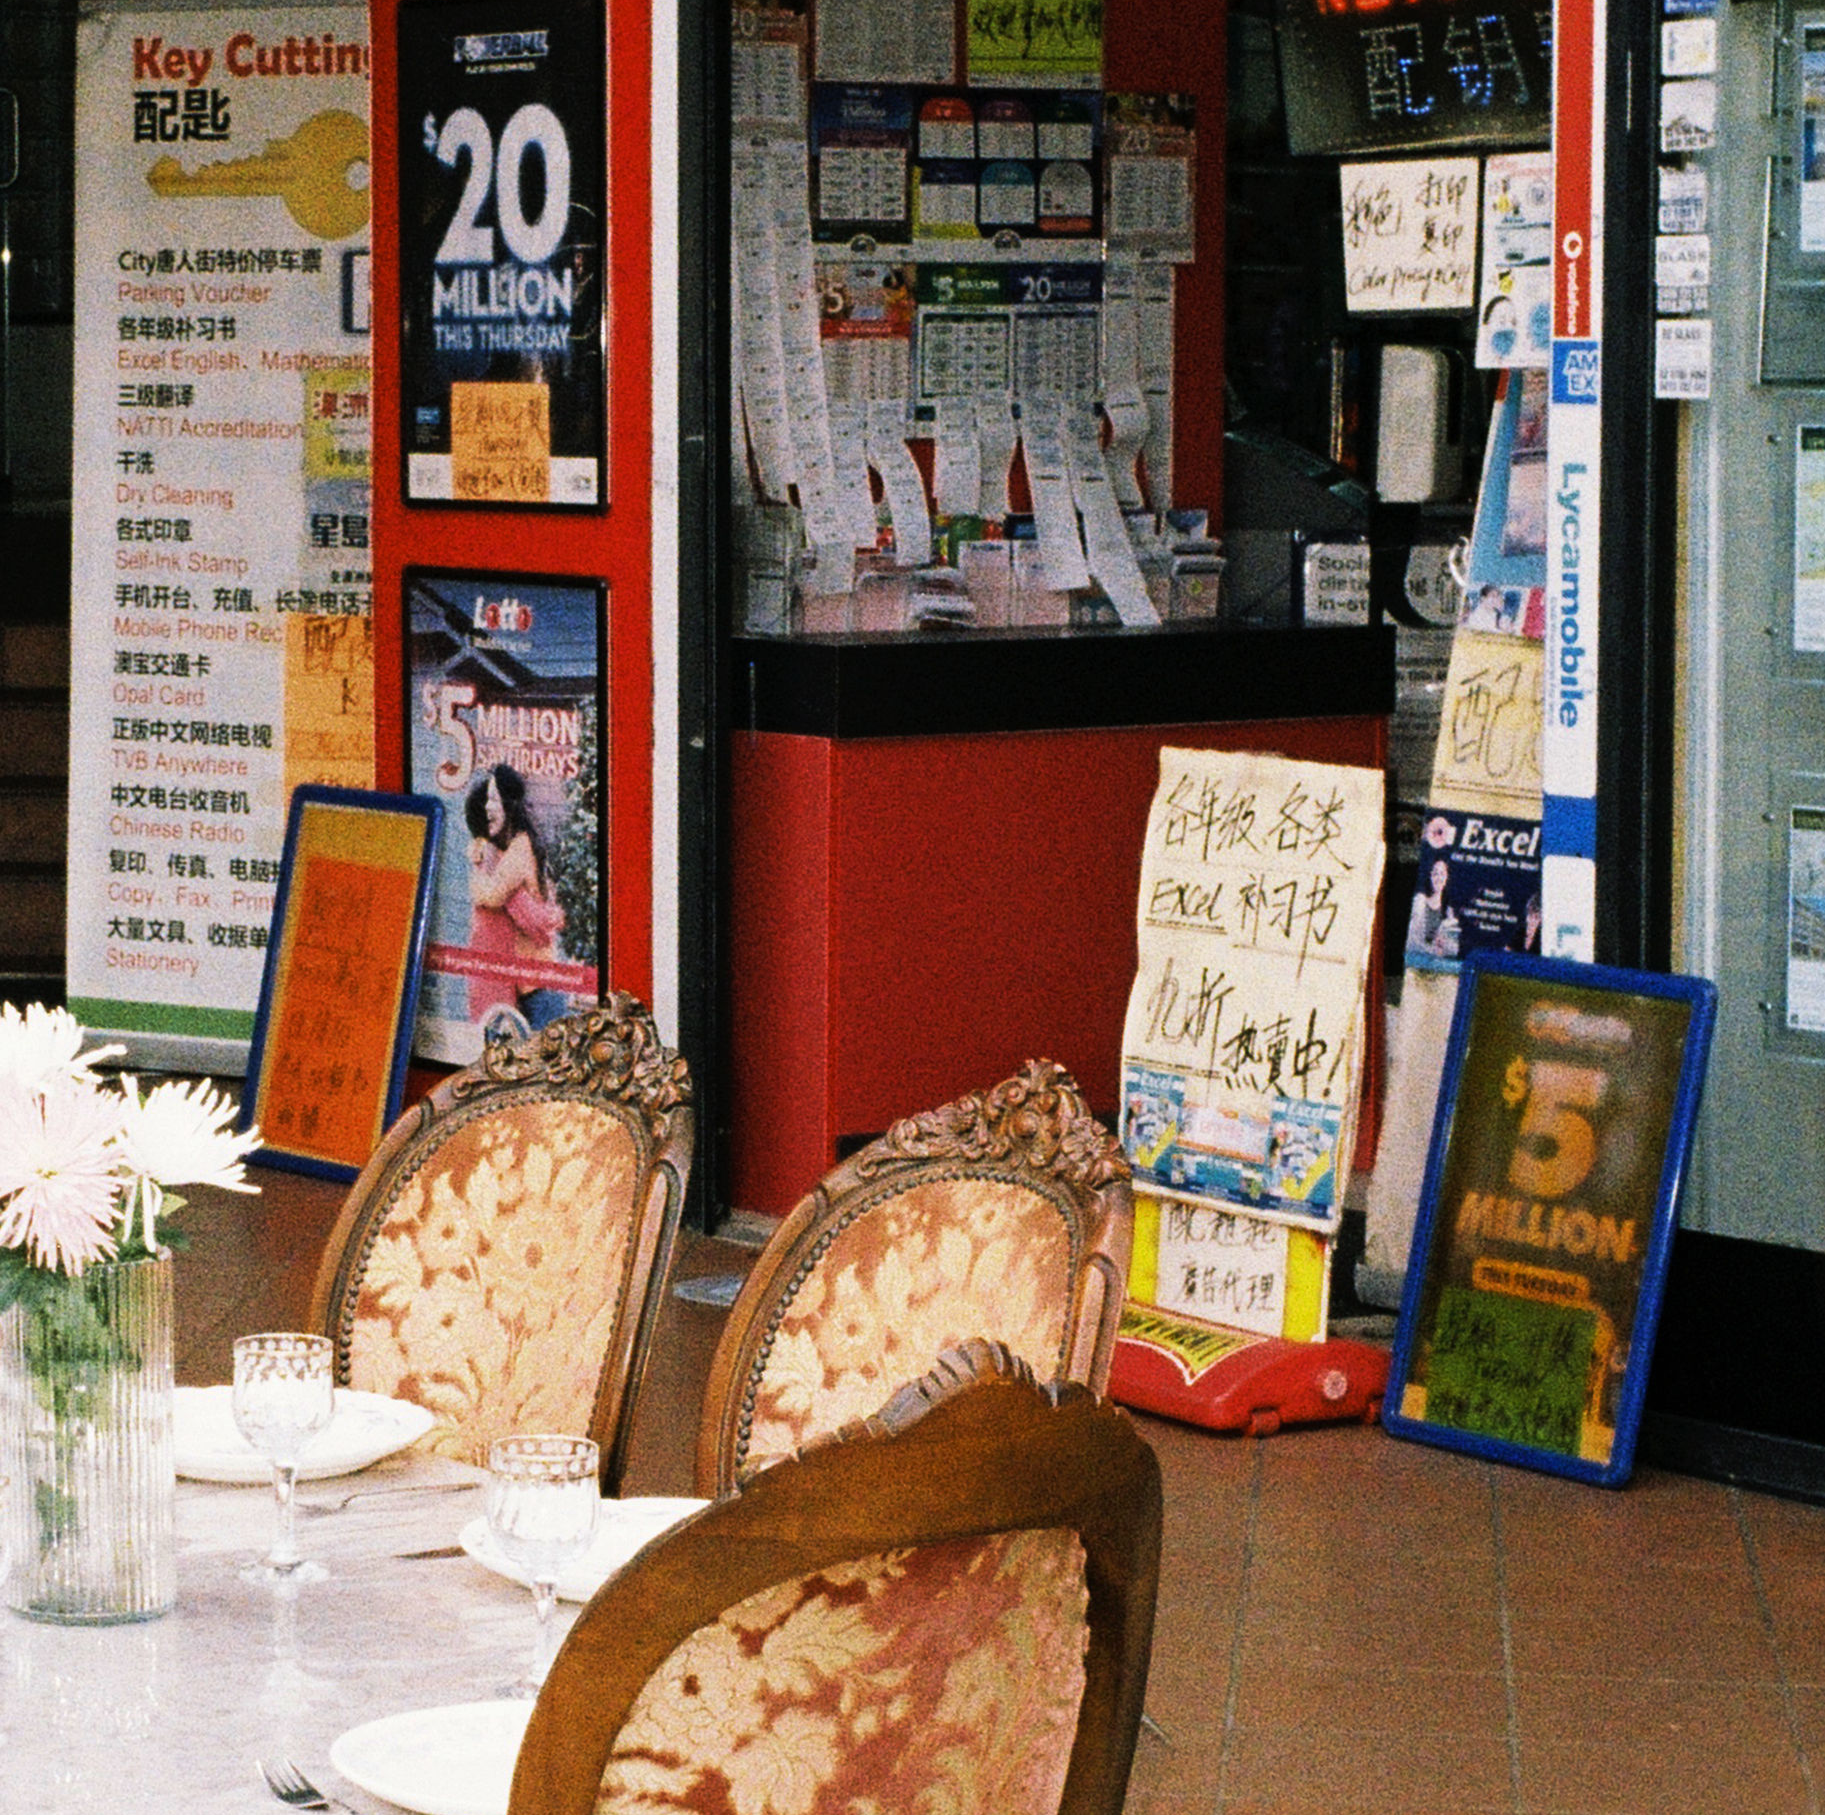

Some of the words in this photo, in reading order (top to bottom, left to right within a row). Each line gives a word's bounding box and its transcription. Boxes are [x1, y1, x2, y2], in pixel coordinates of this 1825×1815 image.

[132, 35, 215, 87] Key
[132, 88, 232, 144] 配匙
[422, 101, 572, 267] $20
[192, 281, 273, 306] Voucher
[432, 266, 574, 319] MILLION
[434, 322, 476, 350] THIS
[480, 322, 571, 351] THURSDAY
[151, 484, 235, 511] Cleaning
[1559, 462, 1589, 729] Lycamobile
[158, 686, 207, 708] Card
[475, 702, 578, 747] MILLION
[154, 751, 249, 779] Anywhere
[475, 747, 579, 779] SATURDAYS
[108, 814, 184, 841] Chinese
[189, 821, 247, 843] Radio
[1458, 816, 1541, 858] Excel
[105, 946, 201, 979] Stationery
[1455, 1190, 1638, 1263] MILLION
